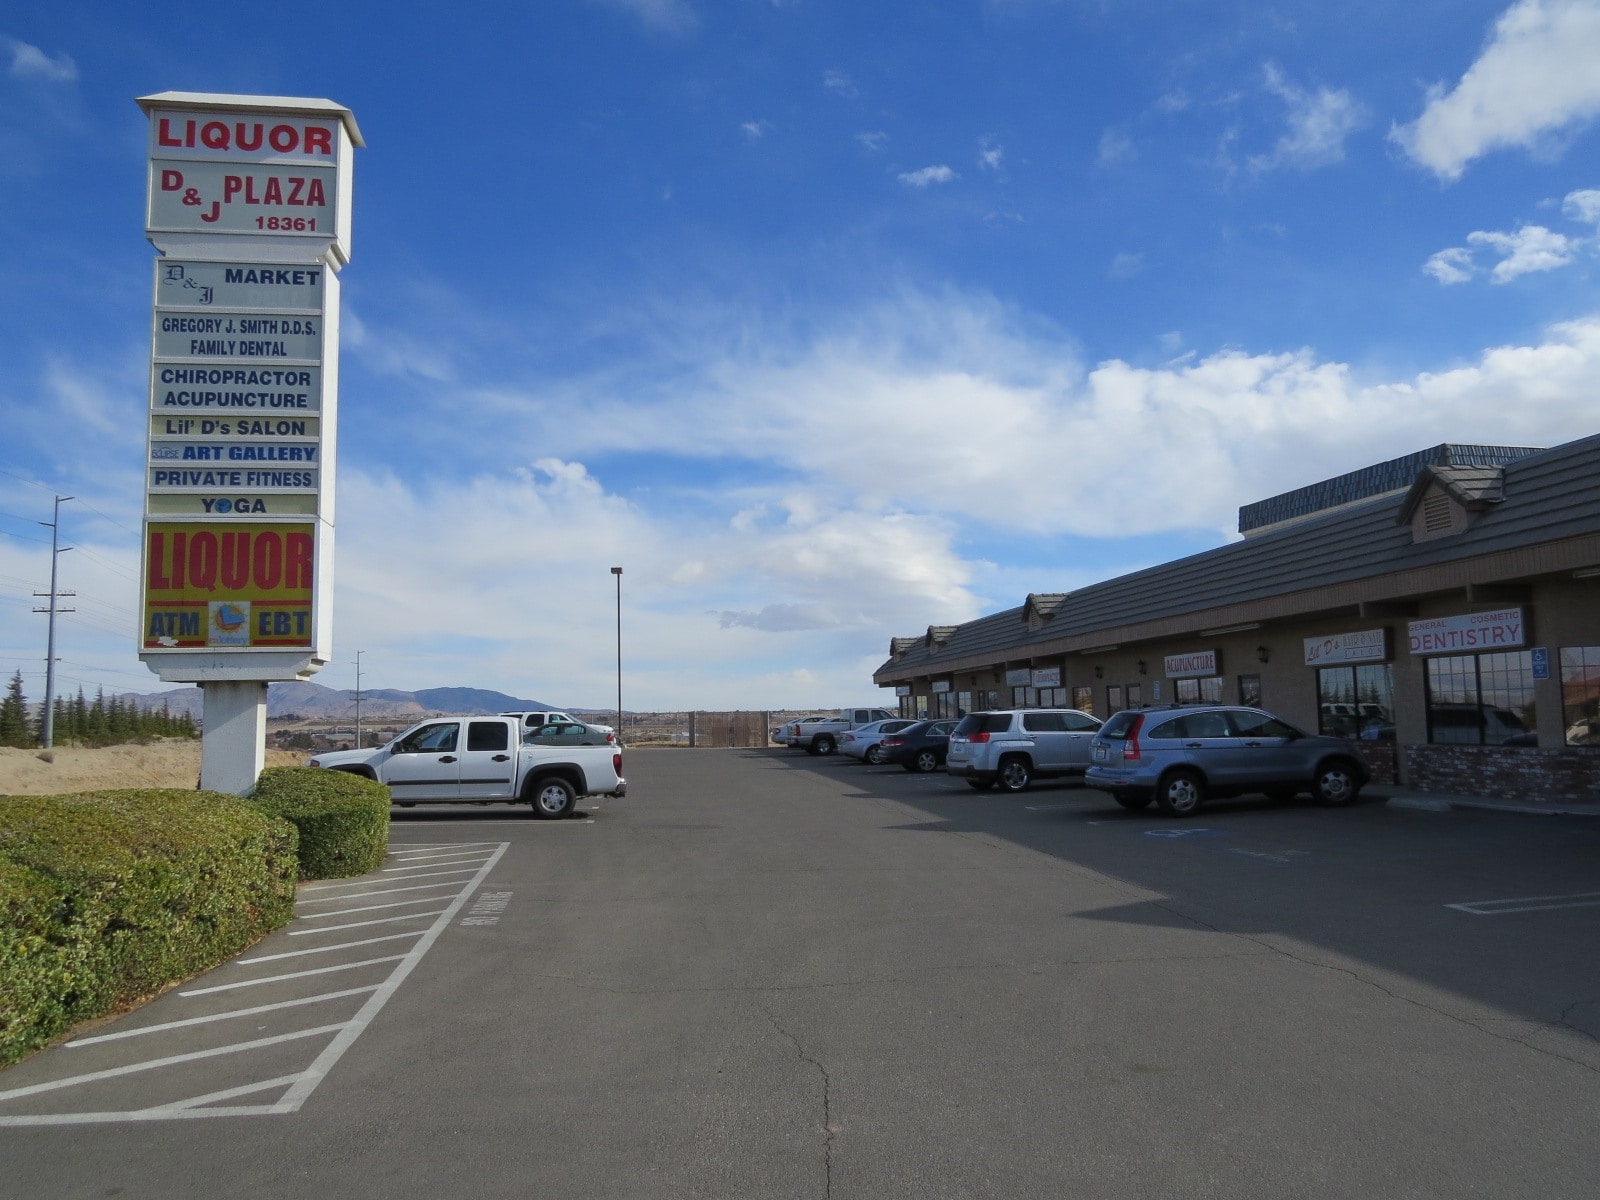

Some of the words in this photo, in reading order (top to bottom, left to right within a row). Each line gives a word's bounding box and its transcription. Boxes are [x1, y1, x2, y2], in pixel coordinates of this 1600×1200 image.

[159, 119, 332, 155] LIQUOR
[162, 170, 184, 191] D
[182, 188, 202, 206] &
[201, 202, 220, 222] J
[224, 176, 326, 206] PLAZA
[256, 216, 316, 232] 18361
[225, 269, 319, 285] MARKET
[162, 318, 222, 333] GREGORY
[226, 320, 236, 333] J.
[240, 320, 278, 334] SMITH
[281, 321, 316, 335] D.D.S.
[191, 340, 236, 355] FAMILY
[240, 341, 287, 356] DENTAL
[161, 369, 310, 386] CHIROPRACTOR
[164, 391, 307, 407] ACUPUNCTURE
[166, 420, 194, 434] Lil'
[202, 420, 230, 434] D's
[237, 421, 305, 435] SALON
[183, 446, 223, 460] ART
[229, 447, 316, 461] GALLERY
[155, 471, 240, 486] PRIVATE
[247, 472, 312, 486] FITNESS
[201, 498, 266, 513] YOGA
[150, 532, 313, 592] LIQUOR
[150, 612, 199, 636] ATM
[259, 612, 309, 636] EBT
[1409, 621, 1447, 631] GENERAL
[1470, 611, 1518, 624] COSMETIC
[1410, 624, 1520, 651] DENTISTRY
[1166, 655, 1214, 673] ACUPUNCTURE
